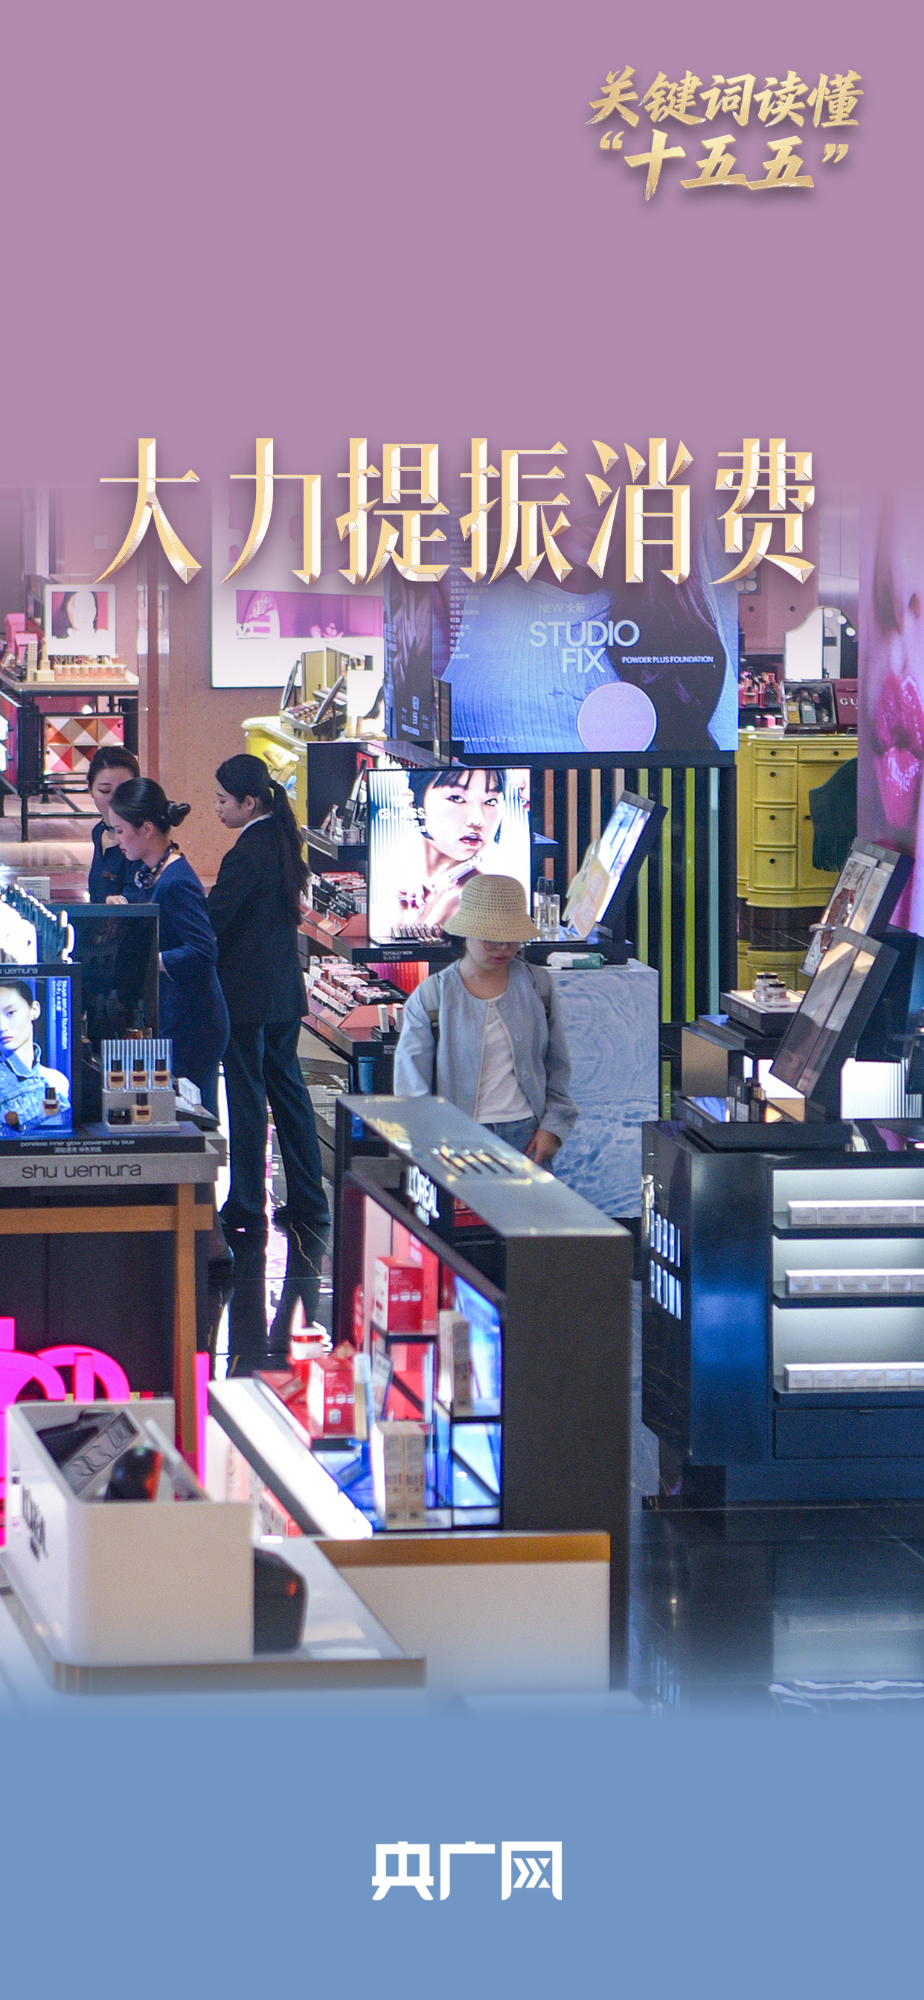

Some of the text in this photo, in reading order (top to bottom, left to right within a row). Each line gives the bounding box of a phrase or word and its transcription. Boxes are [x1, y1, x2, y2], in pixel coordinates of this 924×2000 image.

[539, 603, 586, 614] NEW 全新
[529, 619, 641, 648] STUDIO
[562, 647, 607, 674] FIX
[621, 656, 652, 664] POWDER
[670, 655, 714, 663] FOUNDATION
[839, 697, 858, 706] GU
[4, 967, 38, 975] uemura
[66, 1140, 81, 1148] glow
[83, 1139, 111, 1147] powered
[112, 1139, 120, 1147] by
[22, 1163, 142, 1179] shu uemura
